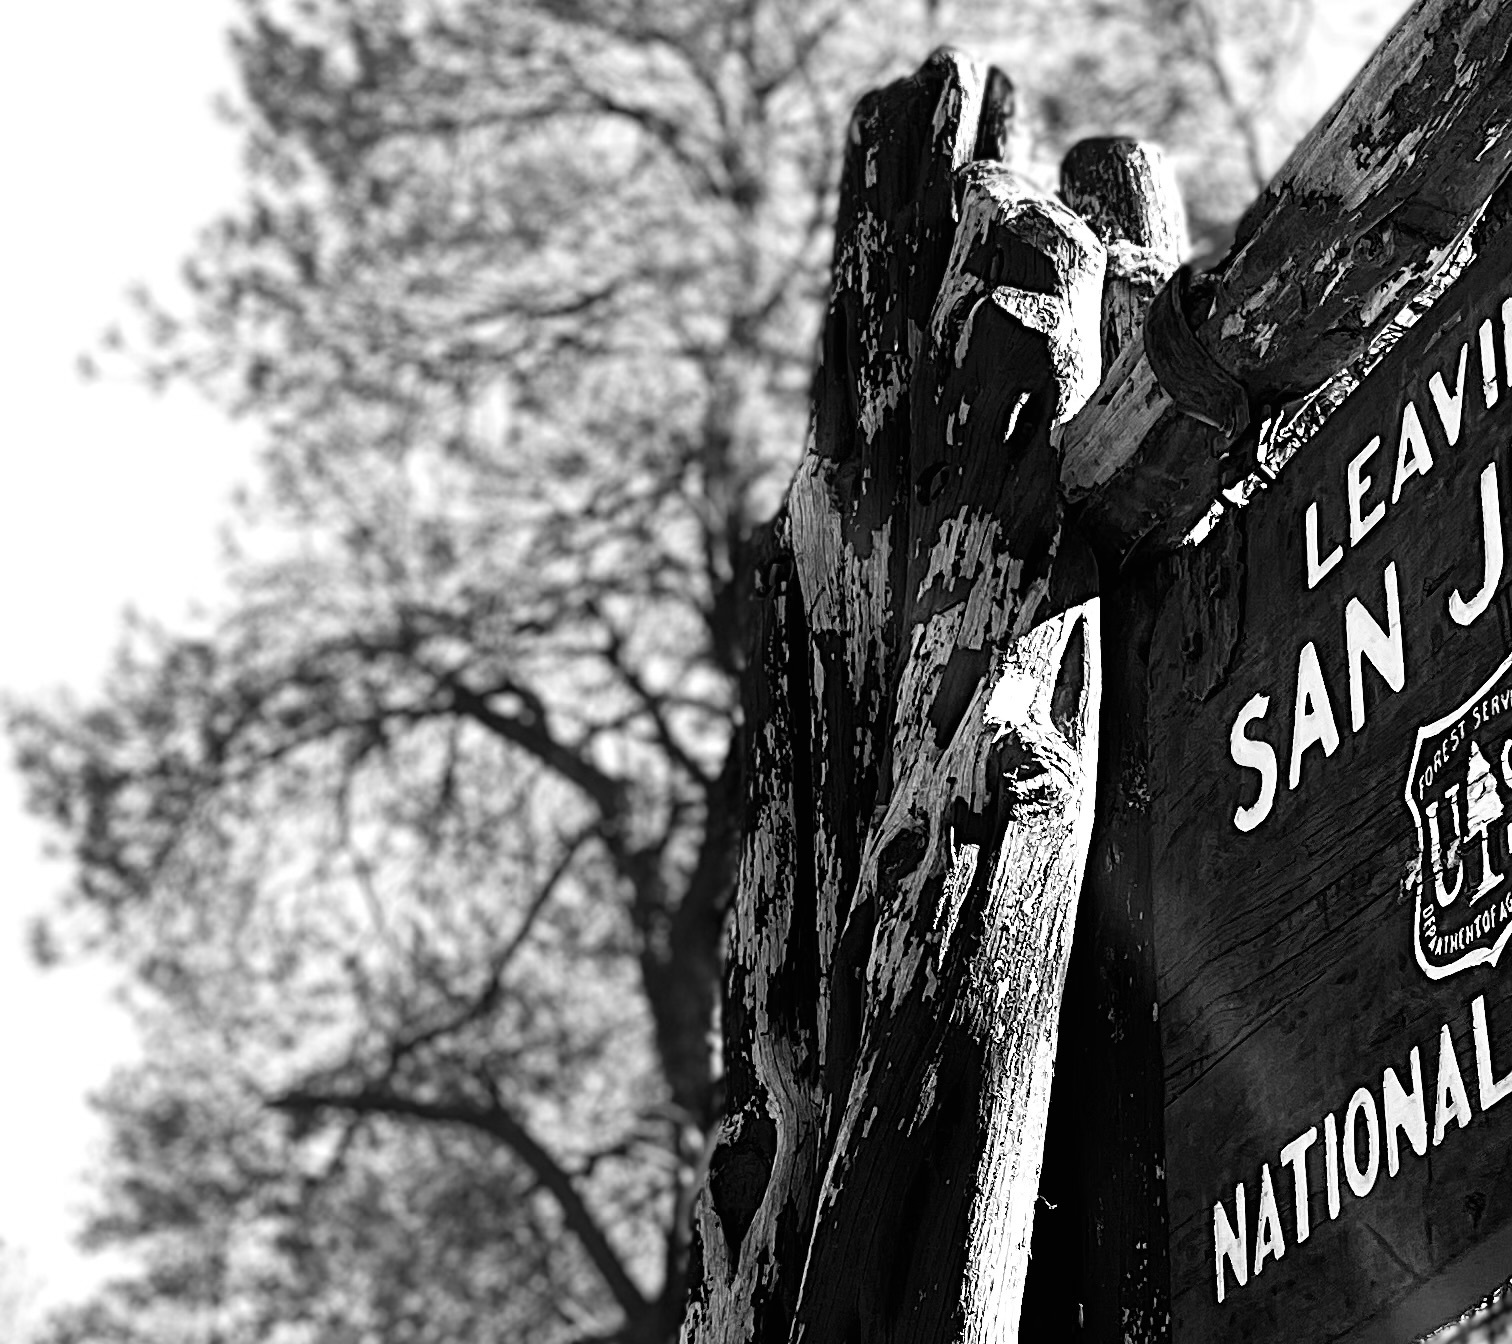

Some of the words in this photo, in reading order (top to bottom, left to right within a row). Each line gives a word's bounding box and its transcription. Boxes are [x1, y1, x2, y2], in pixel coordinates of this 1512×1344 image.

[1229, 560, 1405, 833] SAN
[1418, 719, 1466, 801] FOREST
[1482, 904, 1498, 933] OF
